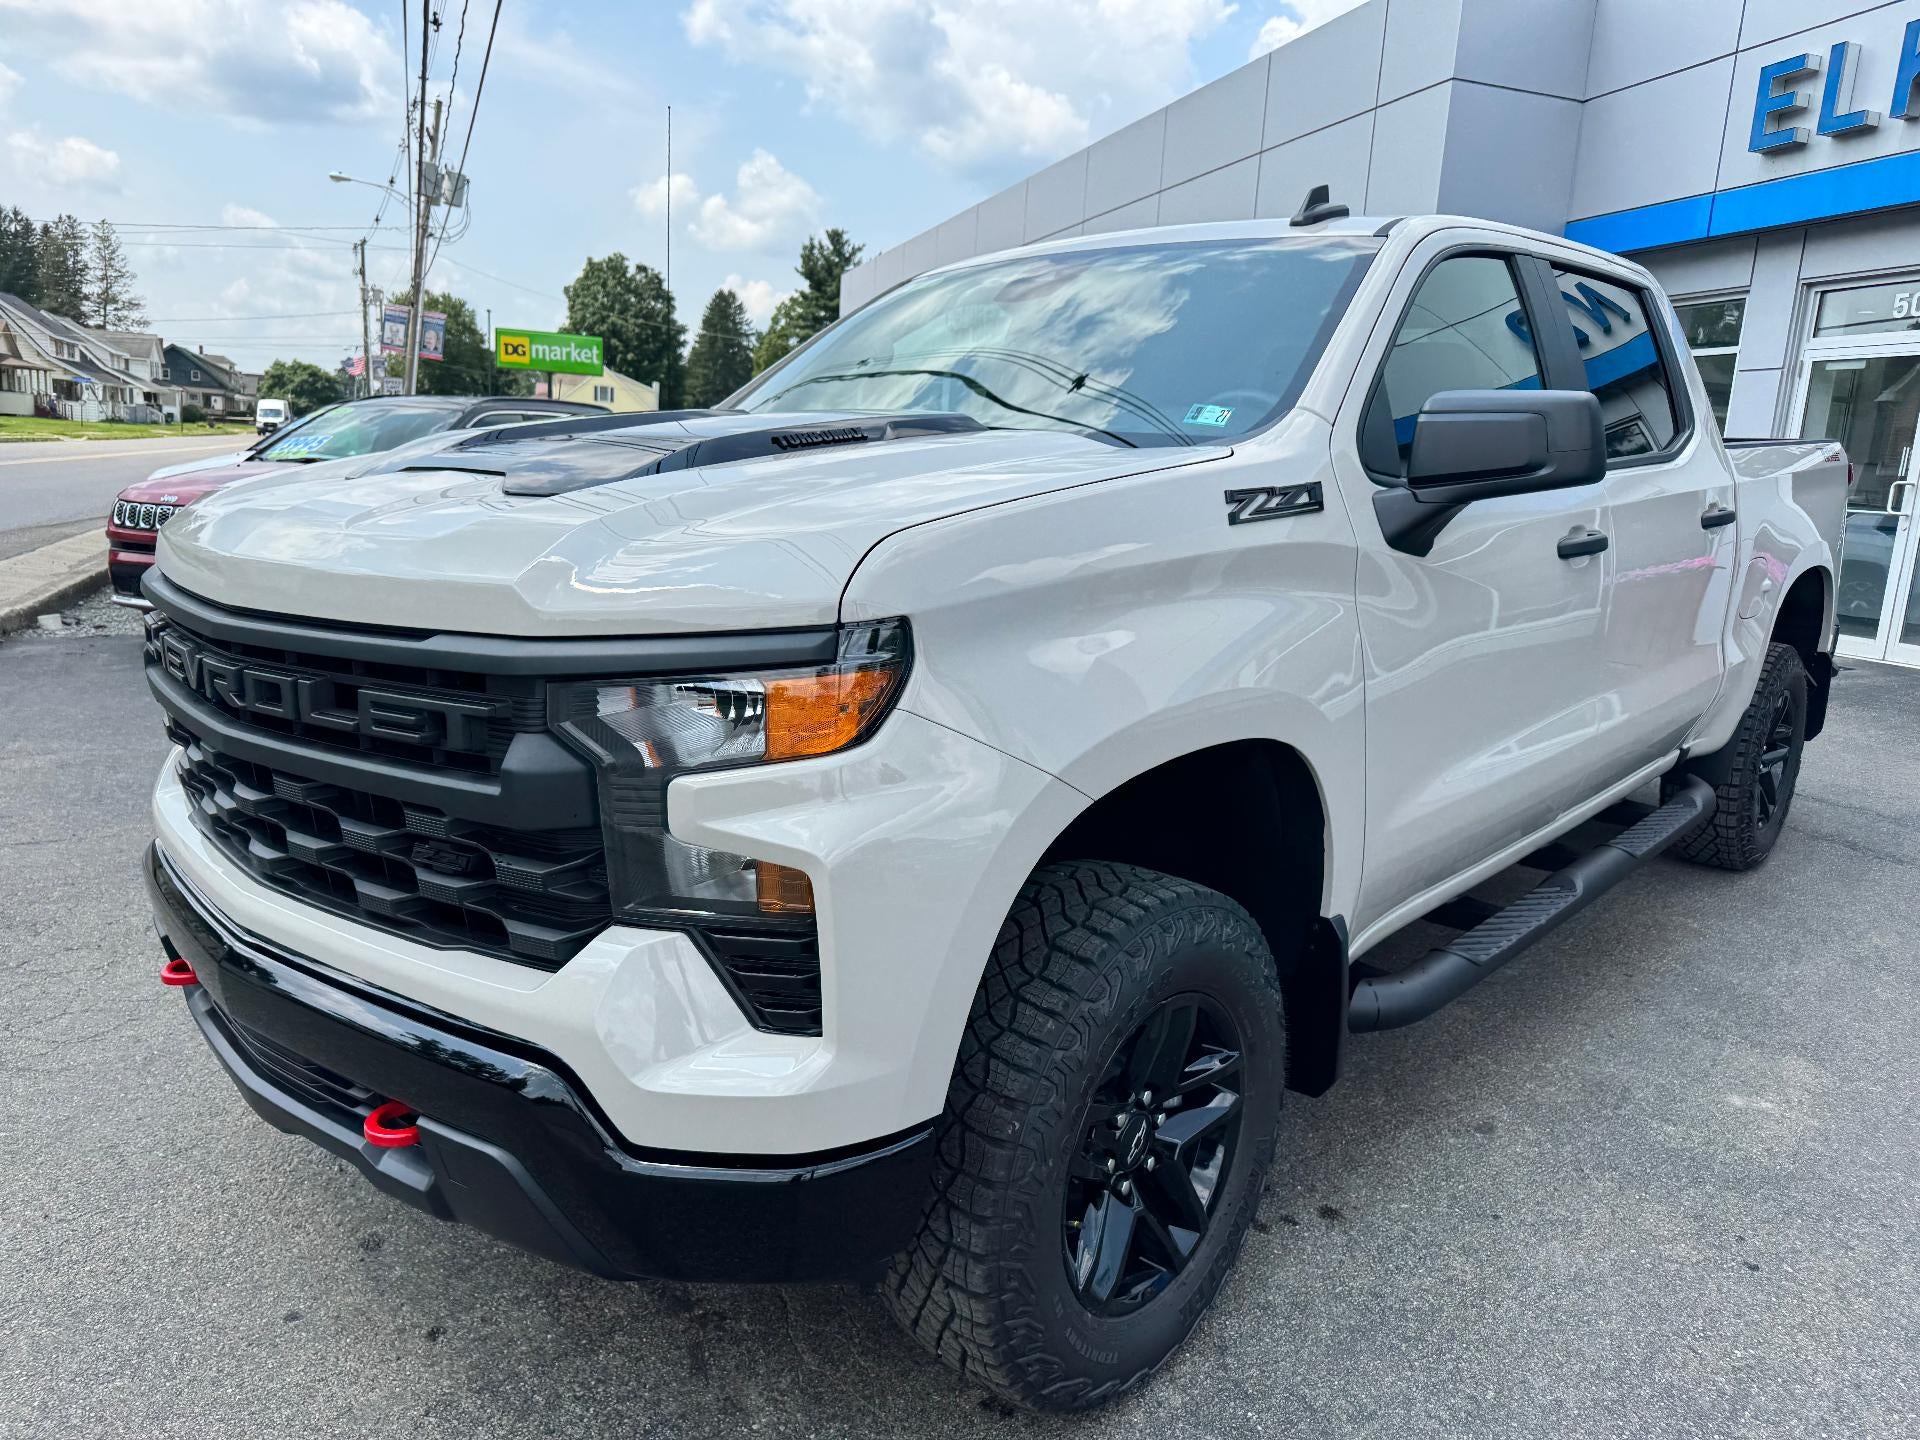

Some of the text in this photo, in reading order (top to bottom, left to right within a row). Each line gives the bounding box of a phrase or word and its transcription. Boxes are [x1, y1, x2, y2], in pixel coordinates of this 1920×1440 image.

[504, 343, 600, 365] DG market
[1214, 409, 1231, 423] 27
[771, 427, 868, 450] TURBOMAX
[161, 494, 178, 503] Jeep
[1224, 481, 1324, 526] Z71
